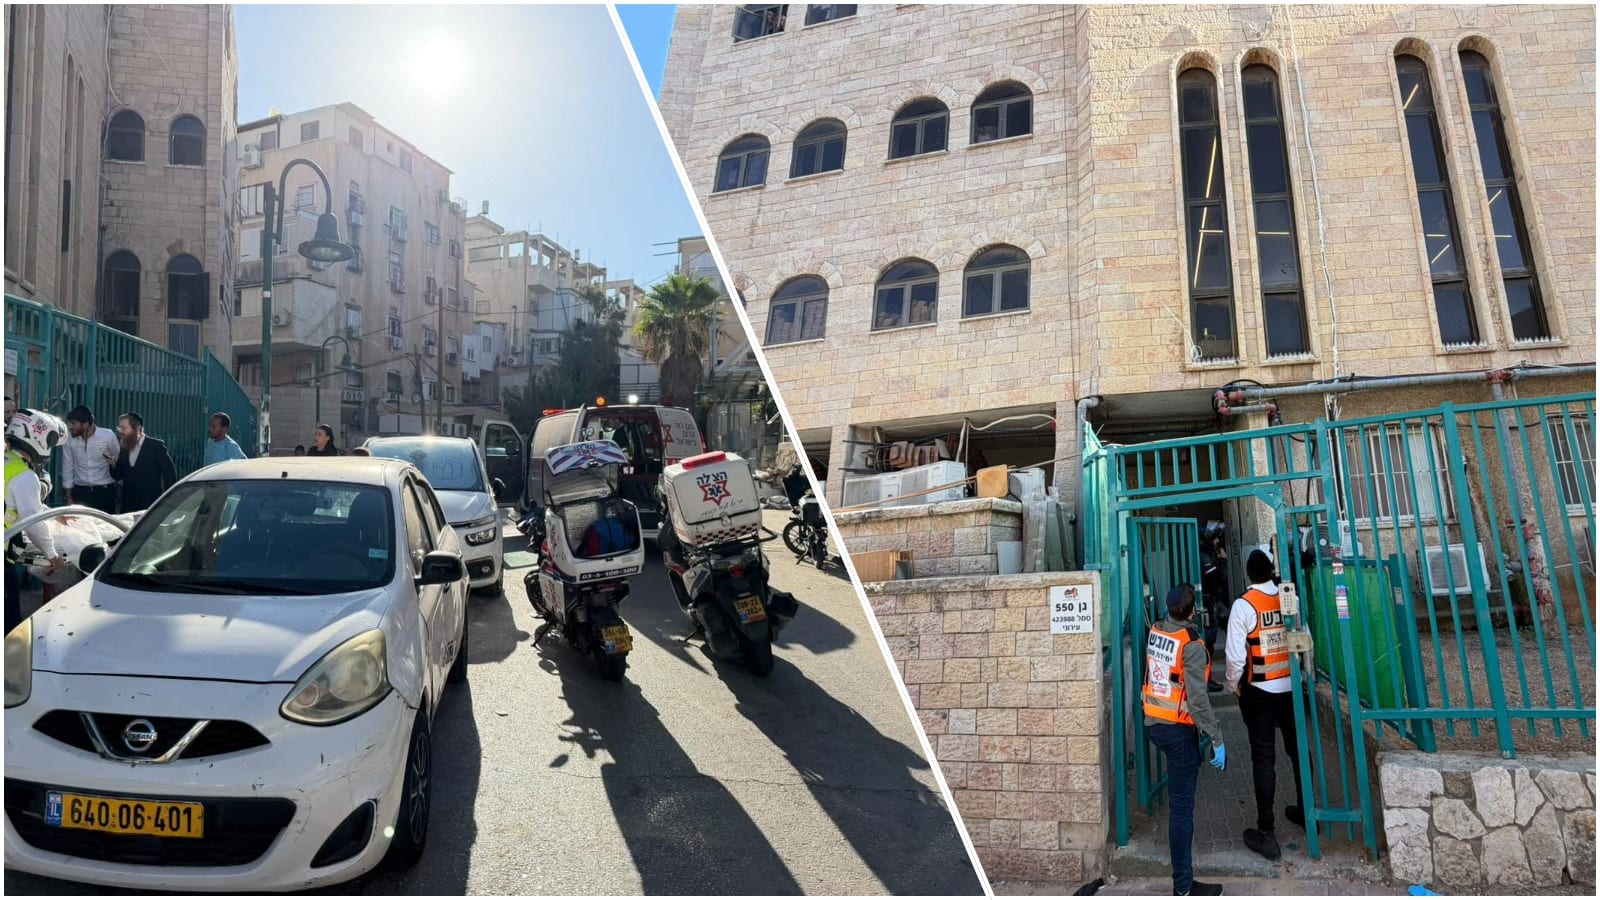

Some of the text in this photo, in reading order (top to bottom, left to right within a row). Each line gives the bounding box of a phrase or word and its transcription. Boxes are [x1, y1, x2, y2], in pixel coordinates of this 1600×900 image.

[696, 471, 728, 485] הצלה
[1055, 602, 1087, 613] גן 550
[1077, 614, 1091, 622] סמל
[1262, 610, 1284, 627] בש
[1149, 632, 1175, 653] חובש
